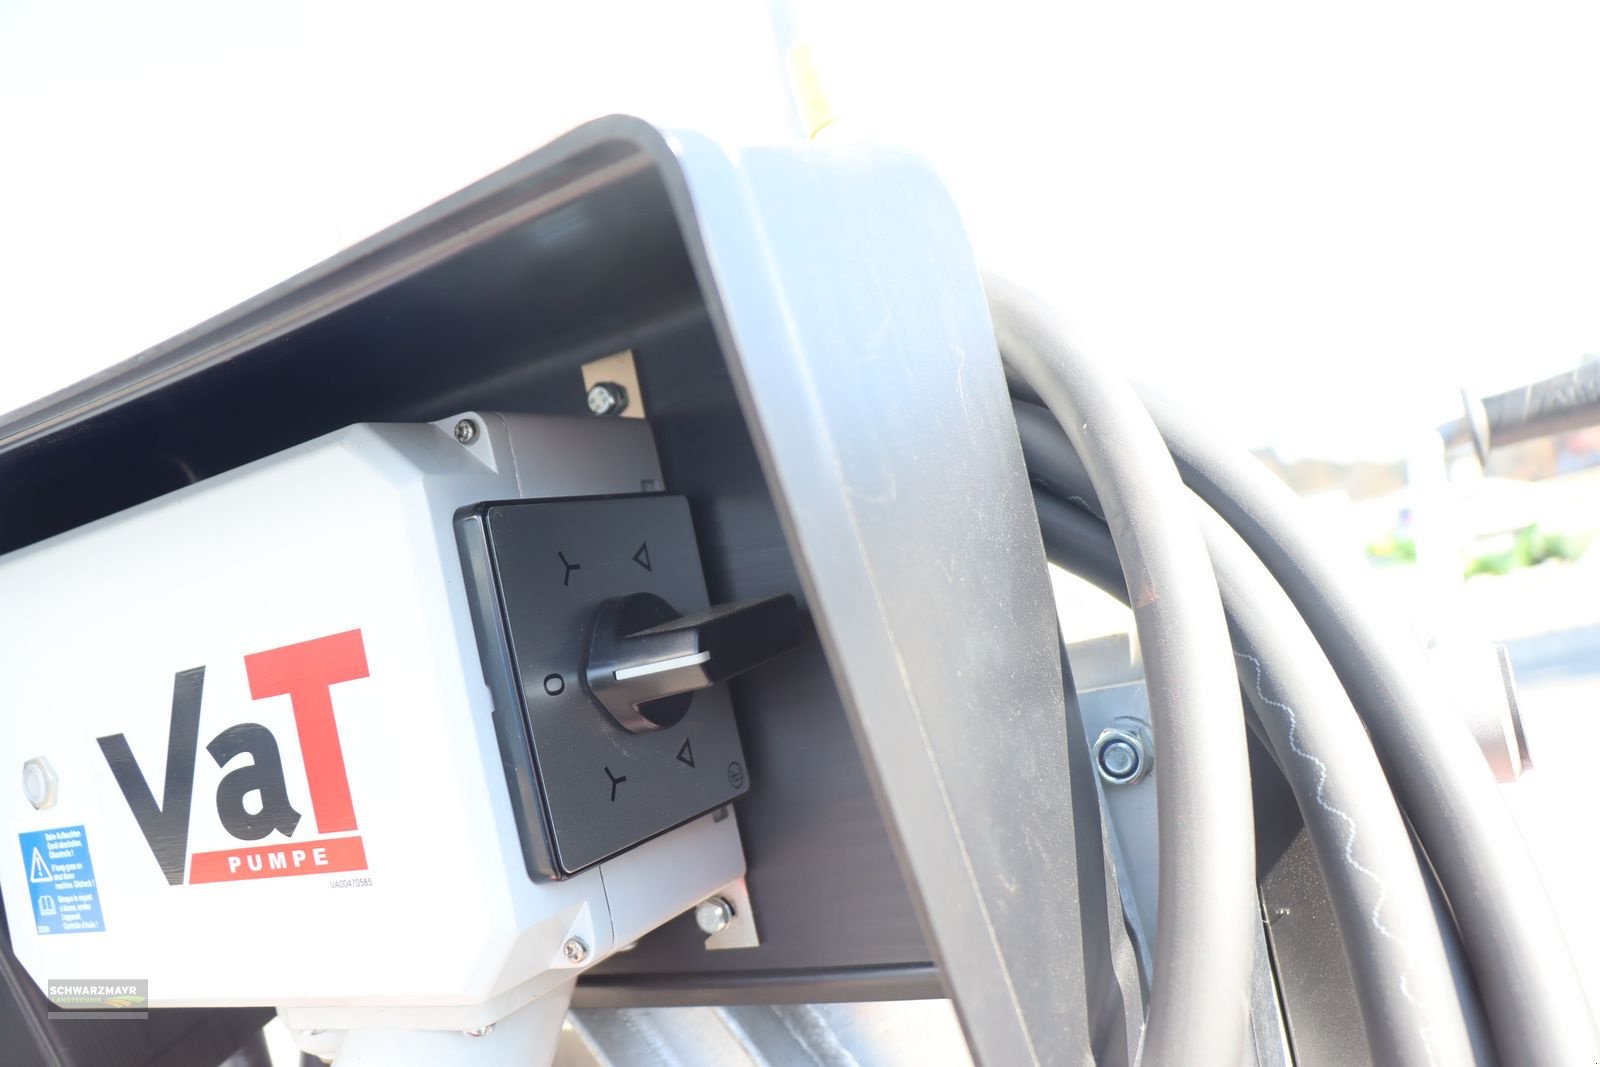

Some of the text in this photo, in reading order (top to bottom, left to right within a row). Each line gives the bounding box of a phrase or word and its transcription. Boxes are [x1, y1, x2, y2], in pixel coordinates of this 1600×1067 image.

[96, 628, 370, 886] VaT
[227, 847, 329, 873] PUMPE
[329, 877, 373, 889] VA00470585
